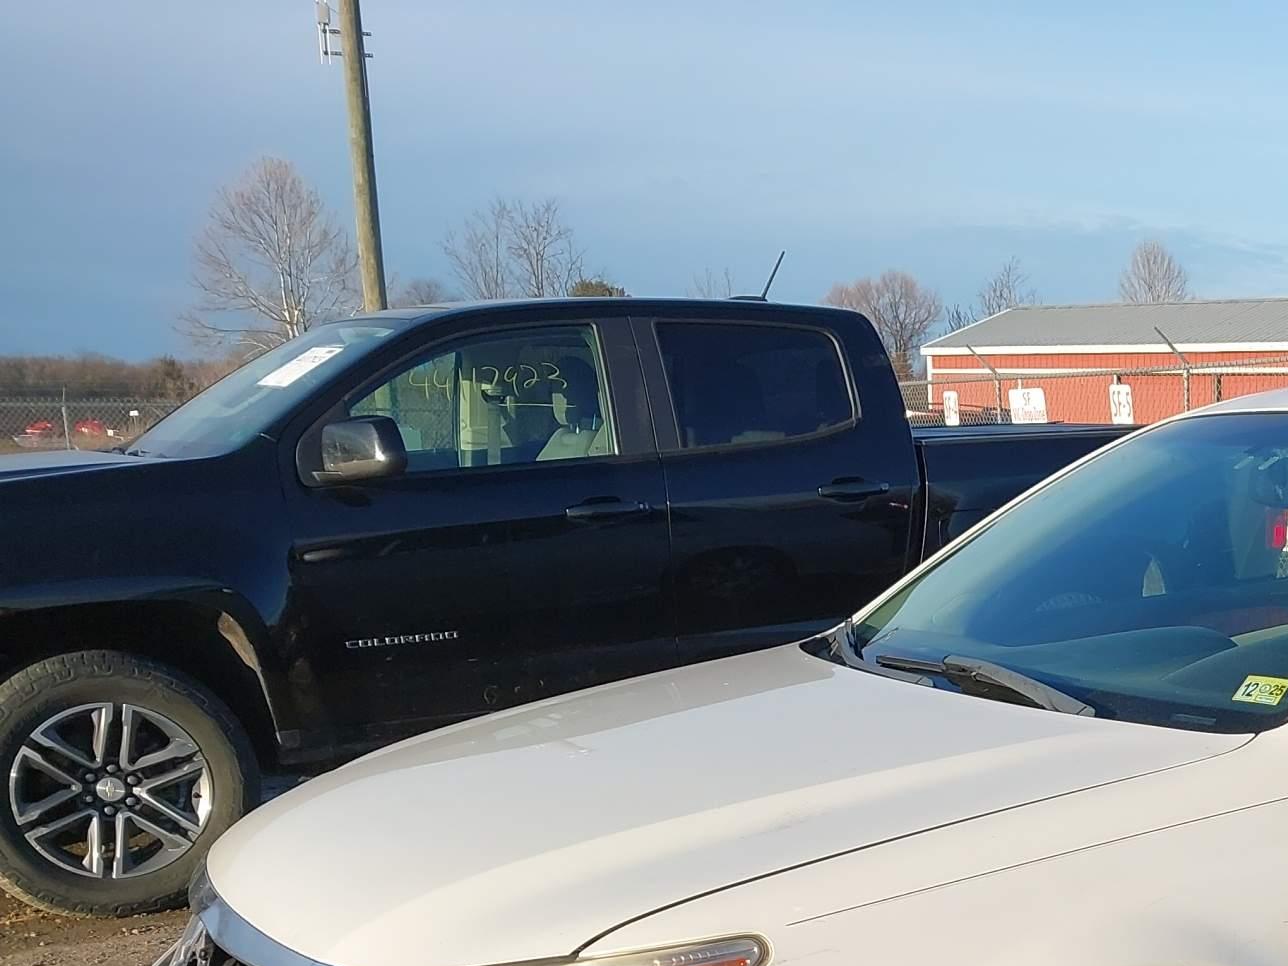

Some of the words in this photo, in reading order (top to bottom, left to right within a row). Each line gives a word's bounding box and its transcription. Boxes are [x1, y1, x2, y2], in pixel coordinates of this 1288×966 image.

[1112, 390, 1131, 417] SF-5
[345, 631, 458, 649] COLORADO
[1241, 682, 1259, 697] 12
[1269, 684, 1286, 697] 25
